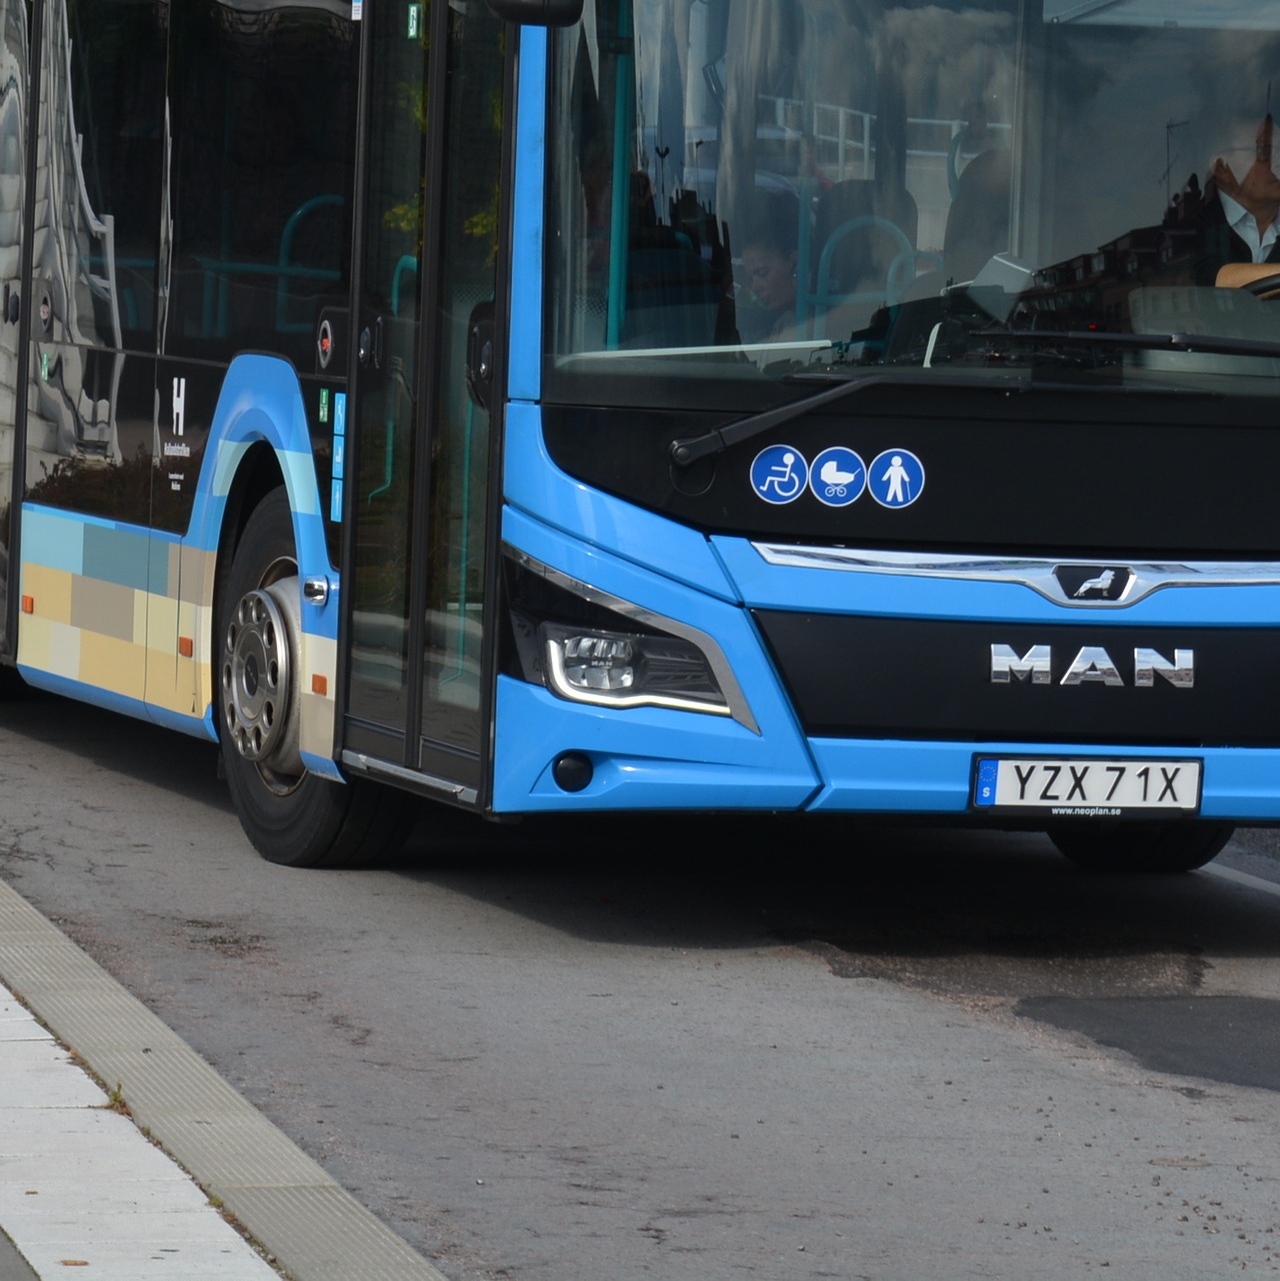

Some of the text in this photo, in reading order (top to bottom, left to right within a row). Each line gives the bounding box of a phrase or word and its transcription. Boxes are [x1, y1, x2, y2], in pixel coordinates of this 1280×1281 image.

[991, 643, 1194, 688] MAN
[1014, 765, 1181, 802] YZX 71X
[1051, 807, 1121, 816] www.neoplan.se
